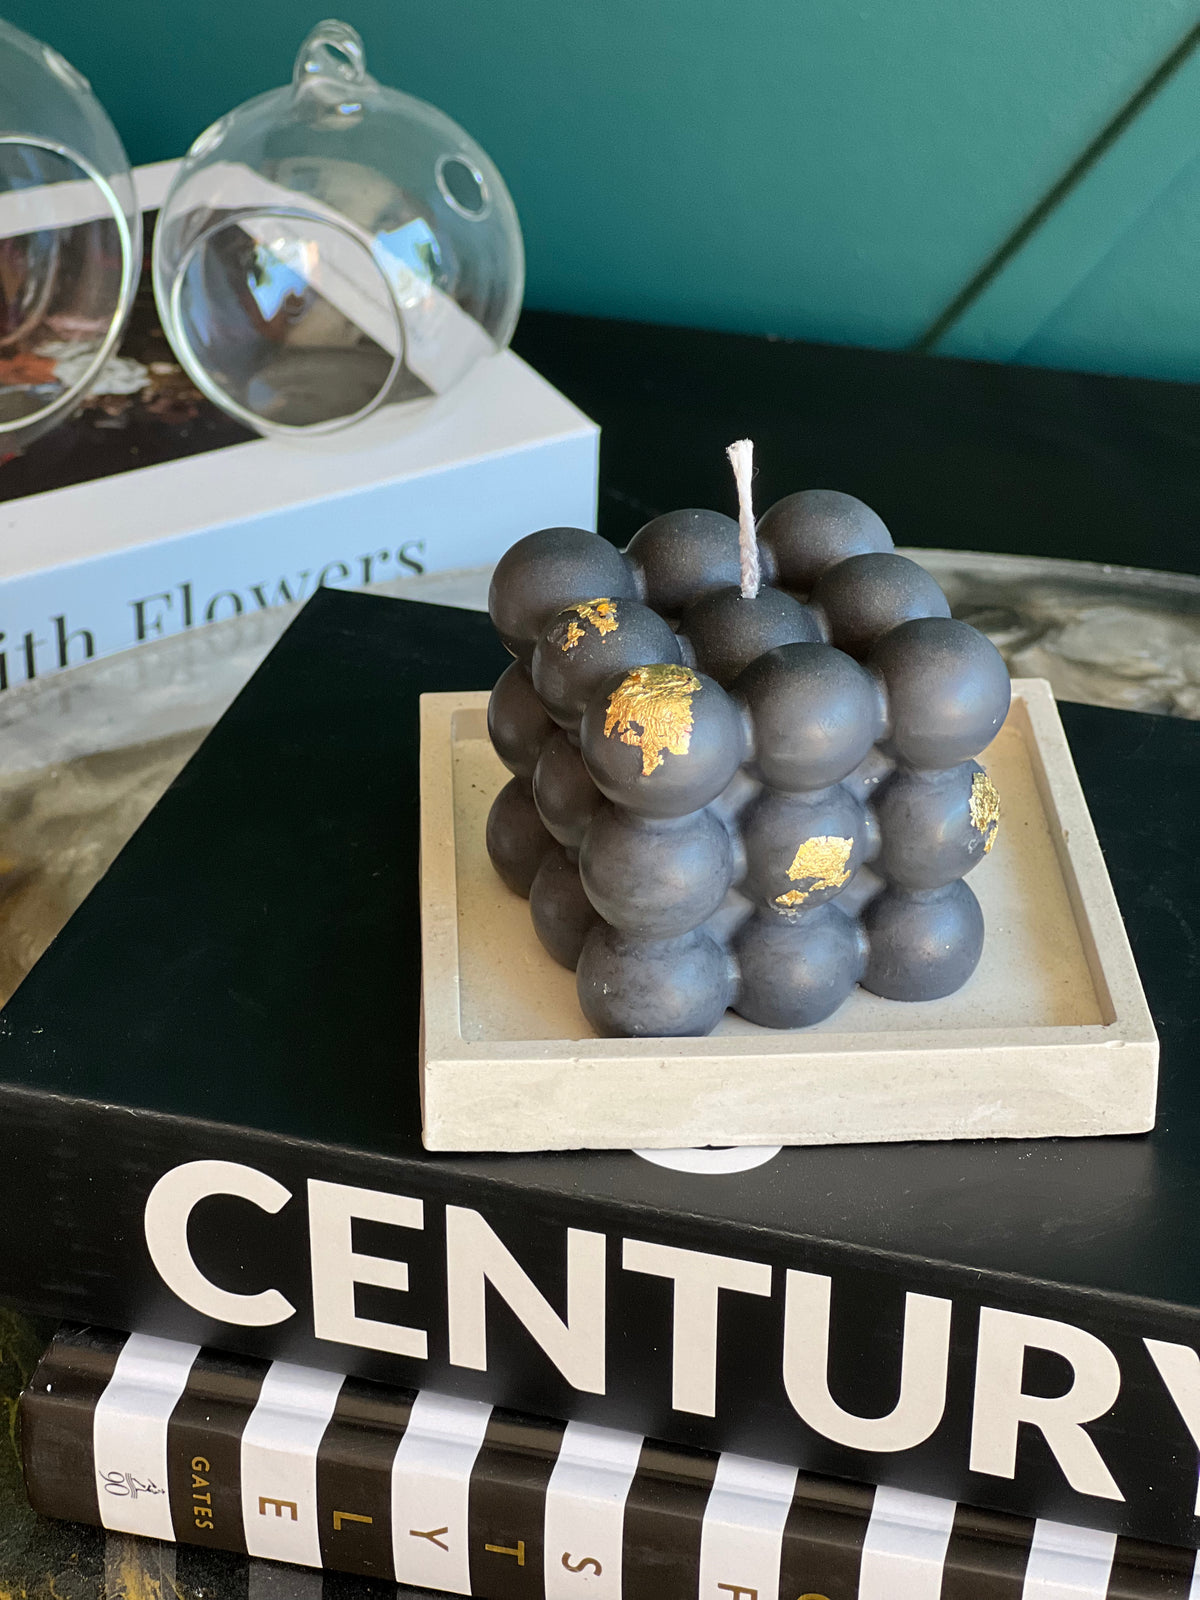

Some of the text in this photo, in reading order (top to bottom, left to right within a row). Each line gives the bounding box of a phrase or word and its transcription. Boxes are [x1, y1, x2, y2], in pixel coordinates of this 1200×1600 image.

[130, 538, 426, 642] Flowers
[99, 1470, 130, 1496] 90
[191, 1456, 214, 1530] GATES
